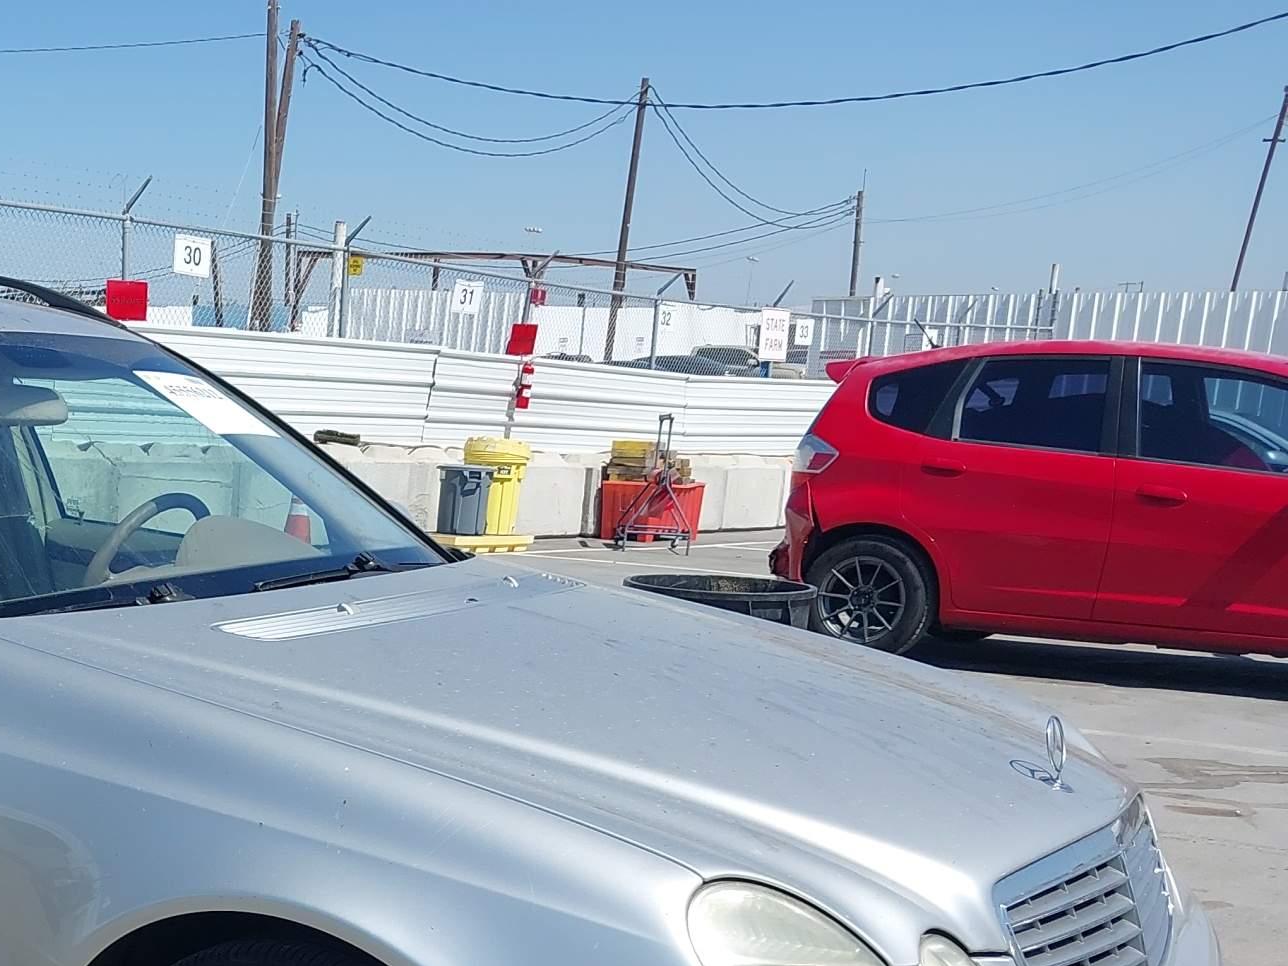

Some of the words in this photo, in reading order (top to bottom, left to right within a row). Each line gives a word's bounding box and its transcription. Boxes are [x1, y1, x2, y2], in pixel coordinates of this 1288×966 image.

[184, 245, 201, 266] 30
[459, 288, 474, 305] 31
[660, 310, 672, 326] 32
[766, 318, 785, 333] STATE
[799, 324, 809, 339] 33
[764, 337, 783, 352] FARM
